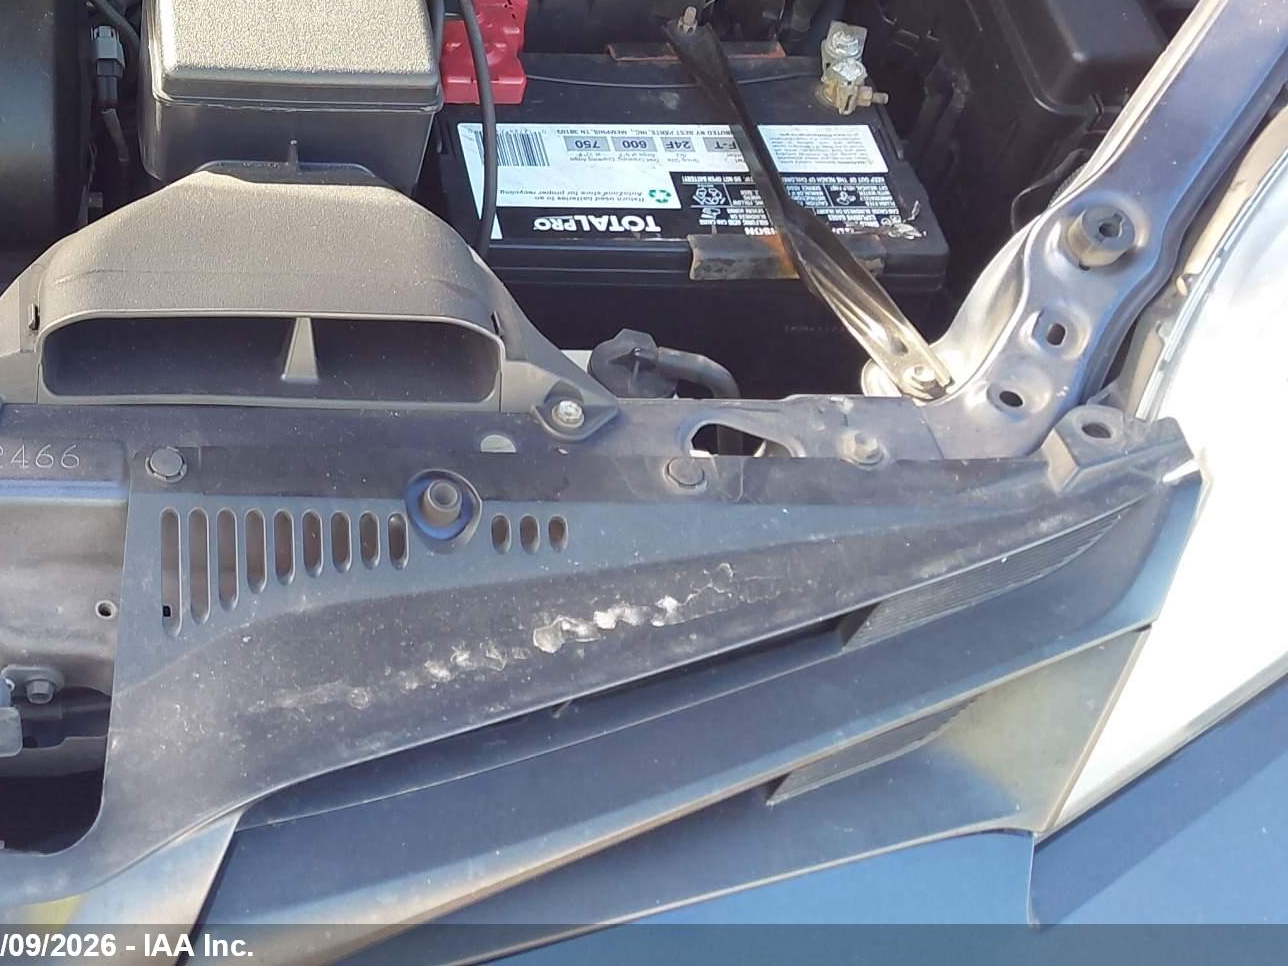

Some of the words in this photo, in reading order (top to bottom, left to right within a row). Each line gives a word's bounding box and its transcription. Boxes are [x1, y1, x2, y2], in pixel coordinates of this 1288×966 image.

[575, 140, 601, 149] 750
[622, 140, 648, 149] 600
[665, 140, 691, 150] 24F
[533, 214, 662, 233] TOTALPRO
